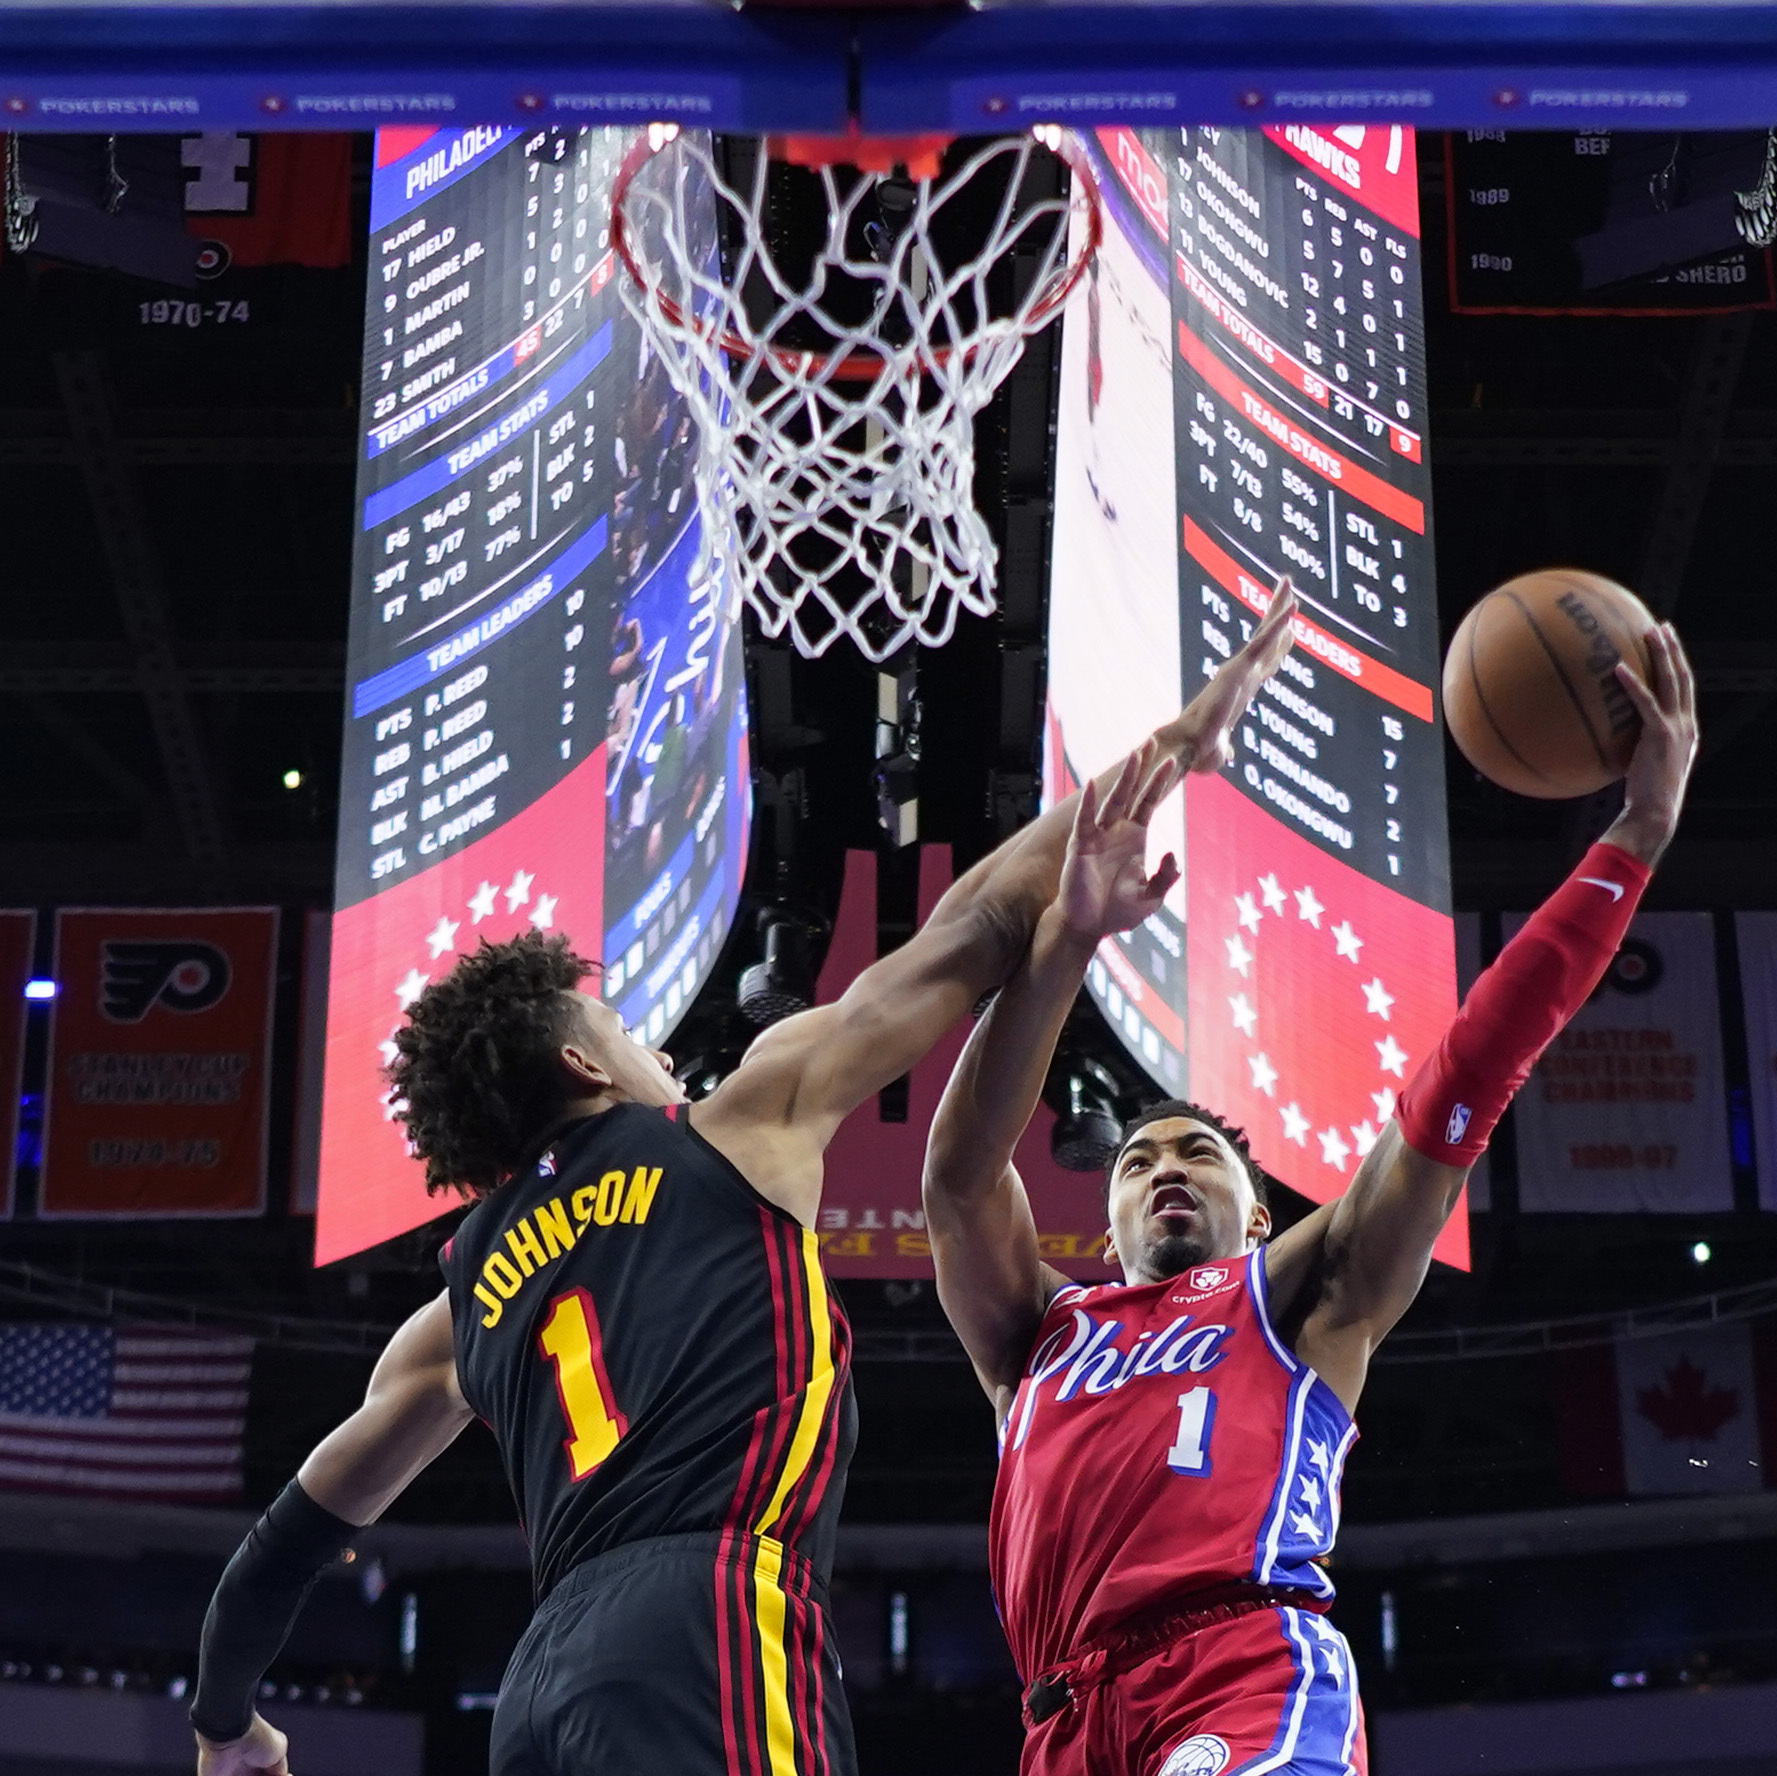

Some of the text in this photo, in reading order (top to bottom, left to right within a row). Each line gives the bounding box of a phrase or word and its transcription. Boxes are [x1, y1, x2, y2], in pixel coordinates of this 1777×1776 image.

[41, 97, 199, 115] POKERSTARS
[296, 96, 455, 113] POKERSTARS
[1019, 94, 1177, 112] POKERSTARS
[1529, 89, 1688, 108] POKERSTARS
[1197, 146, 1260, 220] JOHNSON
[1285, 125, 1361, 189] HAWKS
[382, 218, 426, 254] PLAYER
[382, 226, 456, 282] 17 HIELD
[1197, 181, 1319, 298] OKONGWU 12
[1295, 177, 1407, 260] PTS REB AST FLS
[384, 241, 485, 313] 9 OUBRE JR.
[1198, 214, 1289, 309] BOGDANOVIC
[138, 300, 250, 328] 1970-74
[403, 320, 463, 368] BAMBA
[405, 281, 470, 334] MARTIN
[1181, 263, 1324, 399] TEAM TOTALS 59
[1199, 249, 1322, 365] YOUNG 15
[373, 357, 456, 419] 23 SMITH
[376, 309, 564, 449] TEAM TOTALS 45 22
[447, 389, 549, 475] TEAM STATS
[1241, 391, 1342, 479] TEAM STATS
[385, 455, 523, 554] FG 16/43 37%
[1224, 419, 1379, 546] 22/40 55% STL
[1231, 459, 1380, 580] 7/13 54% BLK
[373, 527, 465, 594] 3PT 3/17
[383, 525, 522, 623] FT 10/13 77%
[1233, 498, 1381, 612] 8/8 100% TO
[375, 589, 585, 741] PTS REED 10
[427, 574, 554, 671] TEAM LEADERS
[370, 729, 495, 812] AST HIELD
[1257, 703, 1318, 759] YOUNG
[370, 753, 510, 845] BLK BAMBA
[1260, 737, 1351, 813] FERNANDO
[1263, 779, 1354, 849] OKONGWU
[370, 795, 497, 880] STL PAYNE
[472, 1166, 664, 1329] JOHNSON
[536, 1284, 629, 1484] 1
[1029, 1308, 1235, 1402] Phila
[1167, 1385, 1218, 1479] 1
